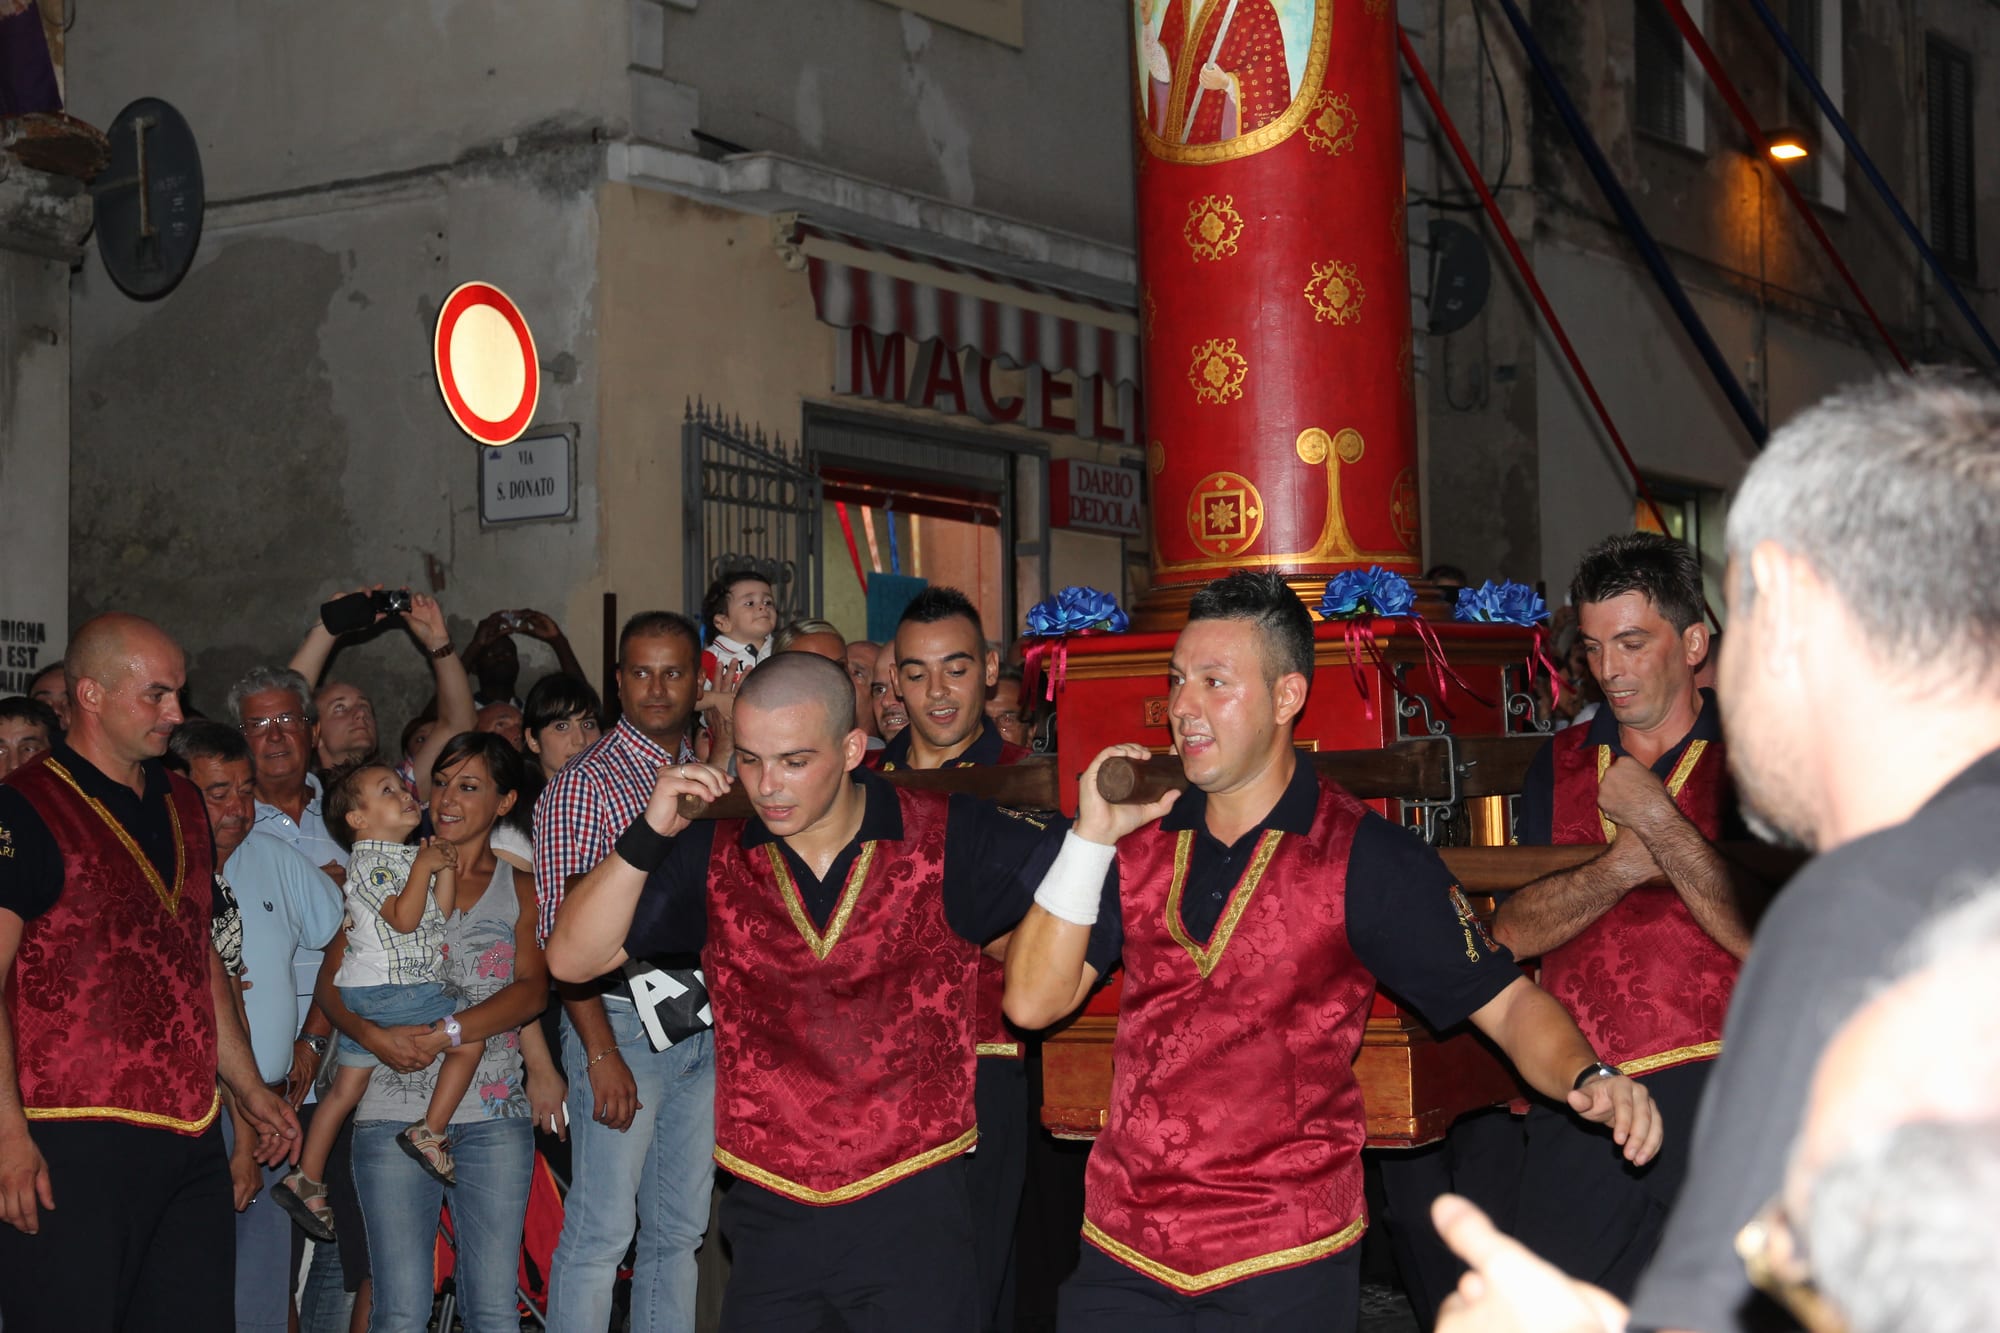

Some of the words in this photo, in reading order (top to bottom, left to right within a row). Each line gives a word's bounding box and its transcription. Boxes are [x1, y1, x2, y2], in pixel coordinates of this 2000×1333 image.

[851, 324, 1144, 445] MACEL
[518, 450, 534, 465] VIA
[496, 481, 506, 501] S.
[509, 476, 555, 500] DONATO
[1077, 466, 1134, 499] DARIO
[1070, 495, 1141, 529] DEDOLA
[7, 645, 38, 669] EST
